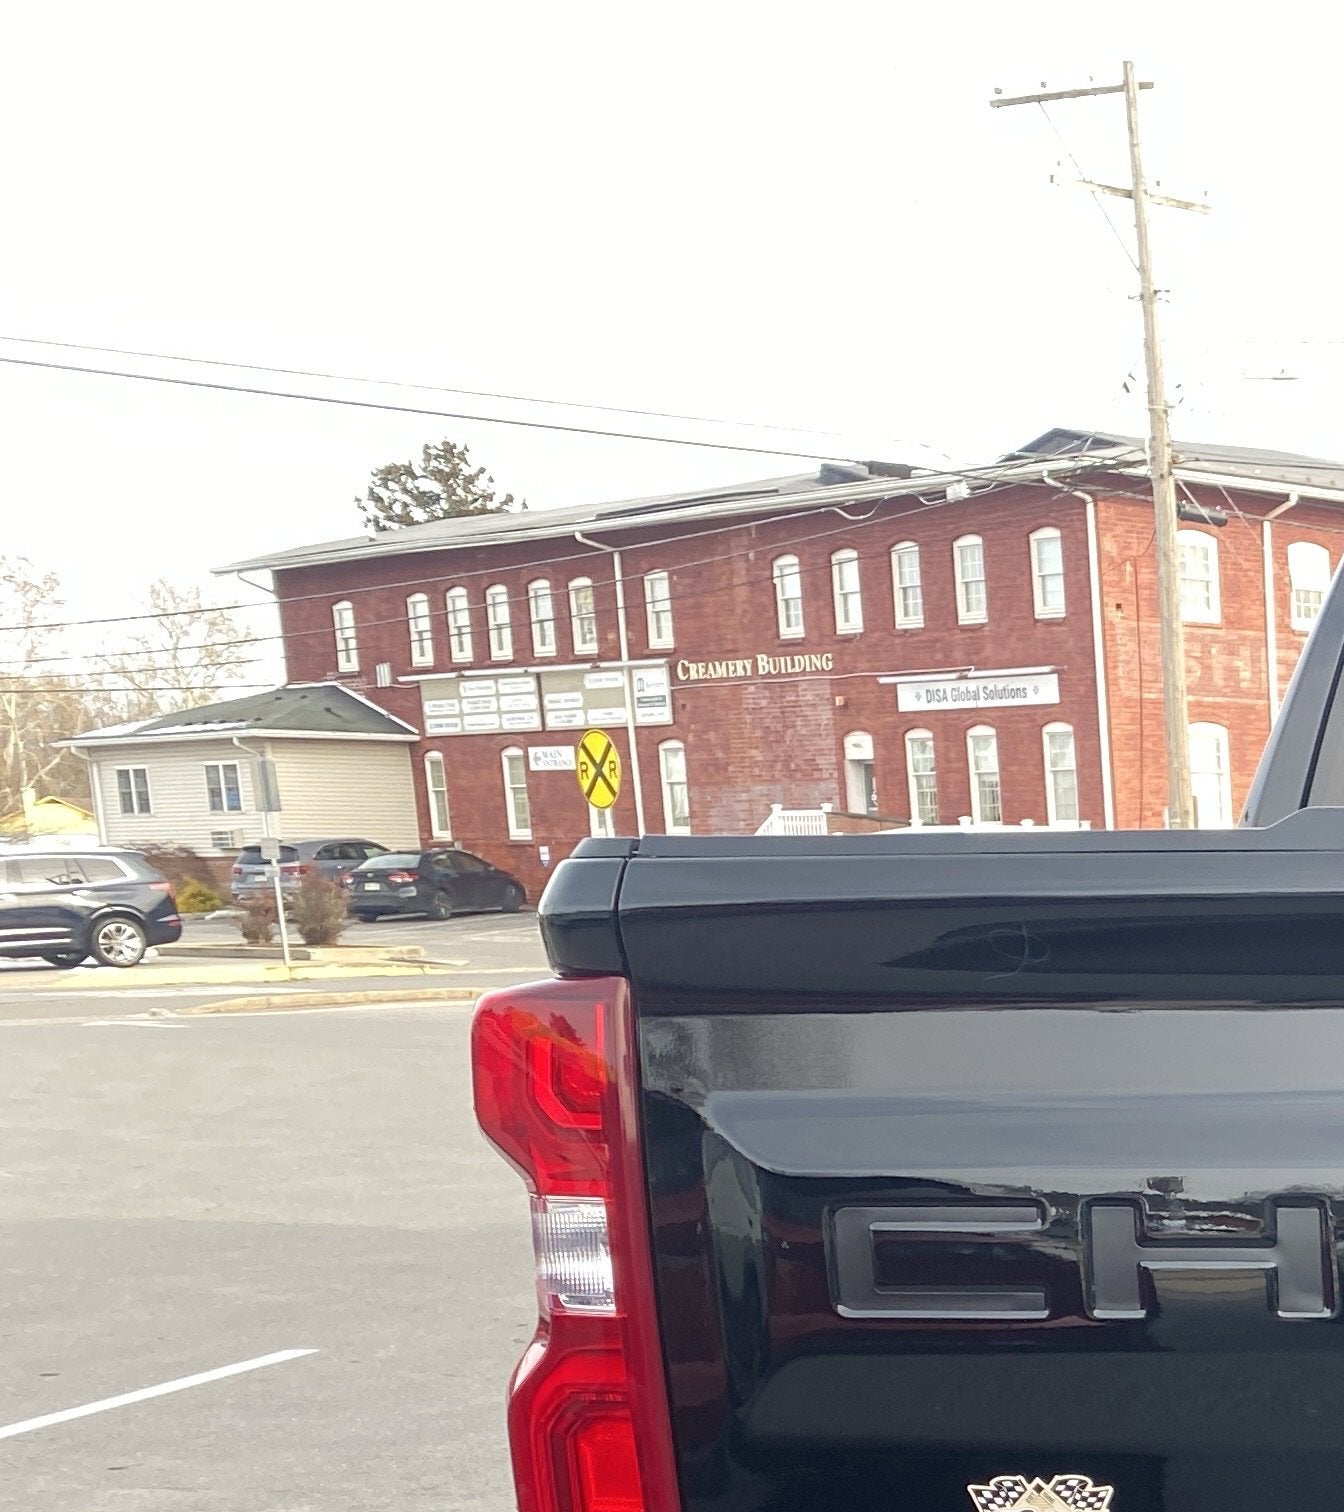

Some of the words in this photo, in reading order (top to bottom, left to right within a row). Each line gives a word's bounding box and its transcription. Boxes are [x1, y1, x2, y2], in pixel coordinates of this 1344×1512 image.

[677, 659, 752, 681] CREAMERY
[756, 653, 833, 675] BUILDING
[925, 688, 949, 704] DISA
[951, 686, 980, 702] Global
[983, 684, 1027, 700] Solutions
[542, 750, 563, 759] MAIN
[580, 761, 589, 780] R
[609, 760, 618, 779] R
